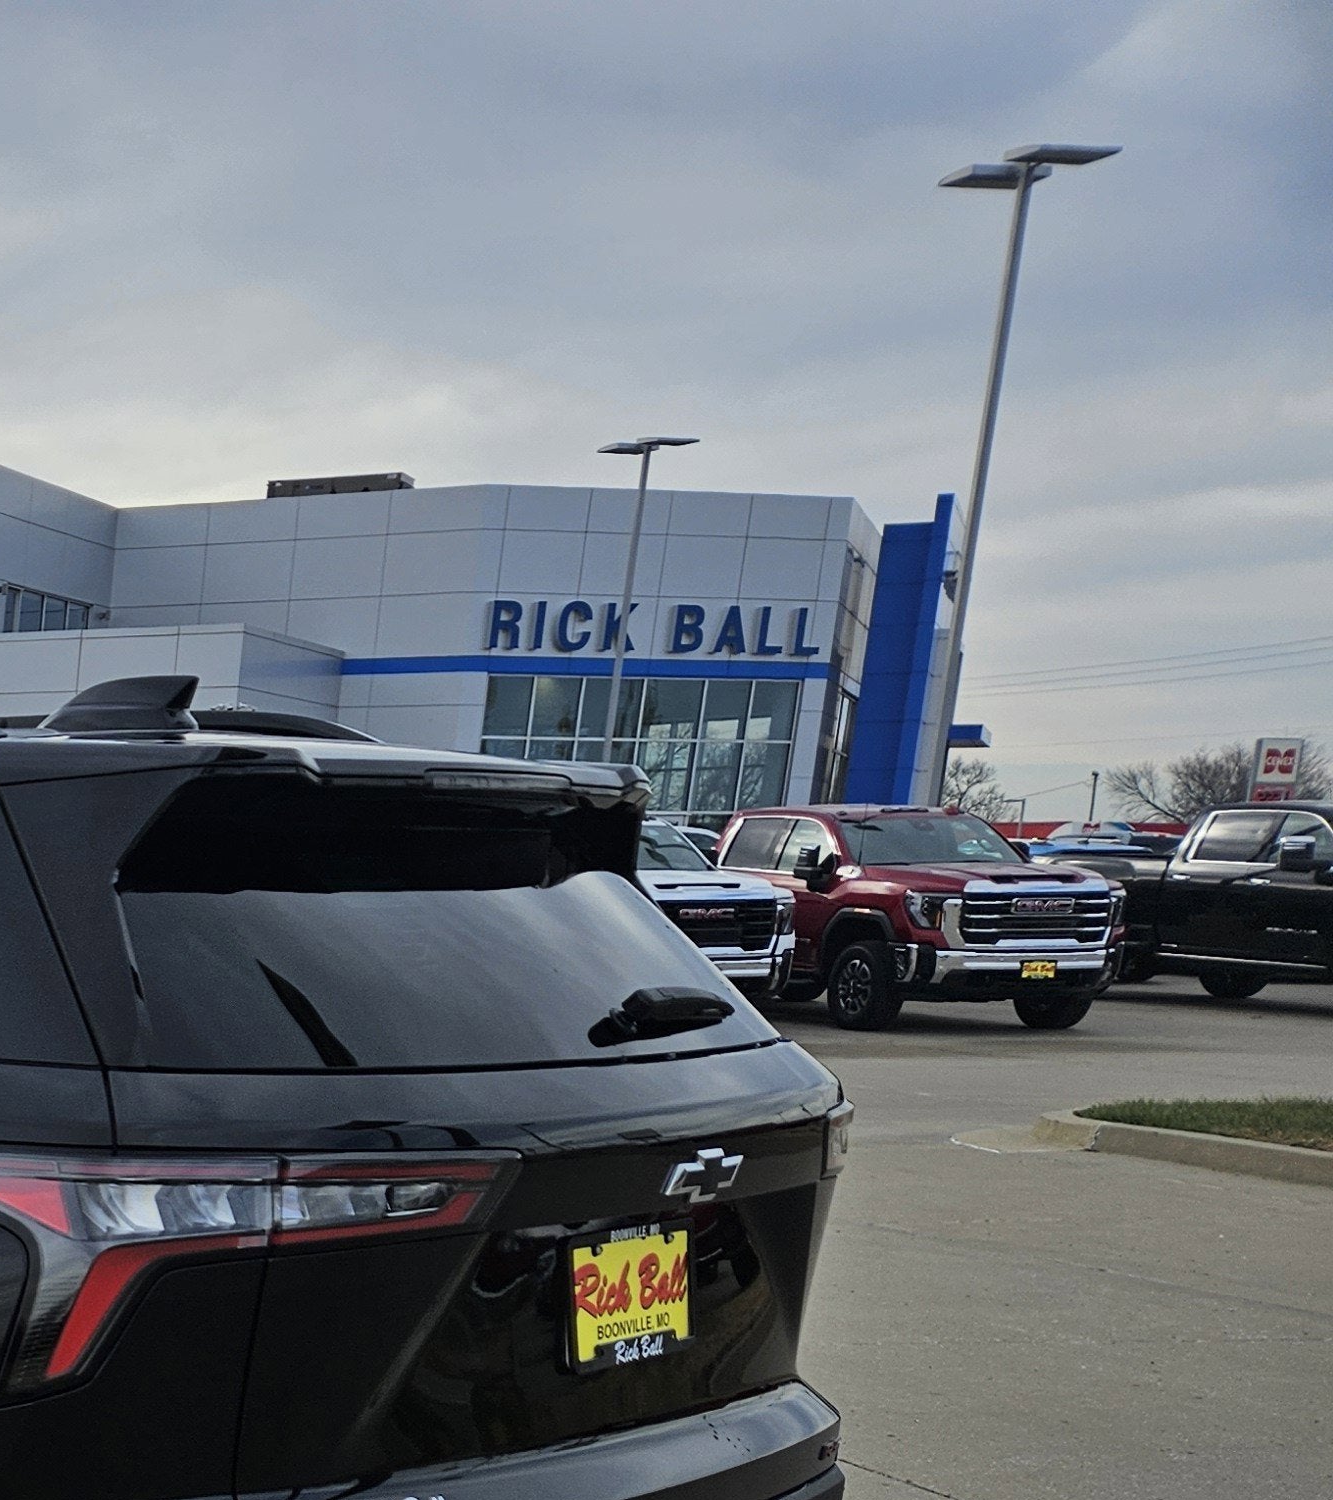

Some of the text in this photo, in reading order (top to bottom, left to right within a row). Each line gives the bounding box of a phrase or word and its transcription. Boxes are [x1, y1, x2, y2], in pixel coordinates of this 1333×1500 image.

[487, 599, 821, 657] RICK BALL
[574, 1252, 688, 1319] Rick Ball
[596, 1312, 670, 1340] BOONVILLE, MO
[614, 1334, 664, 1365] Rick Ball
